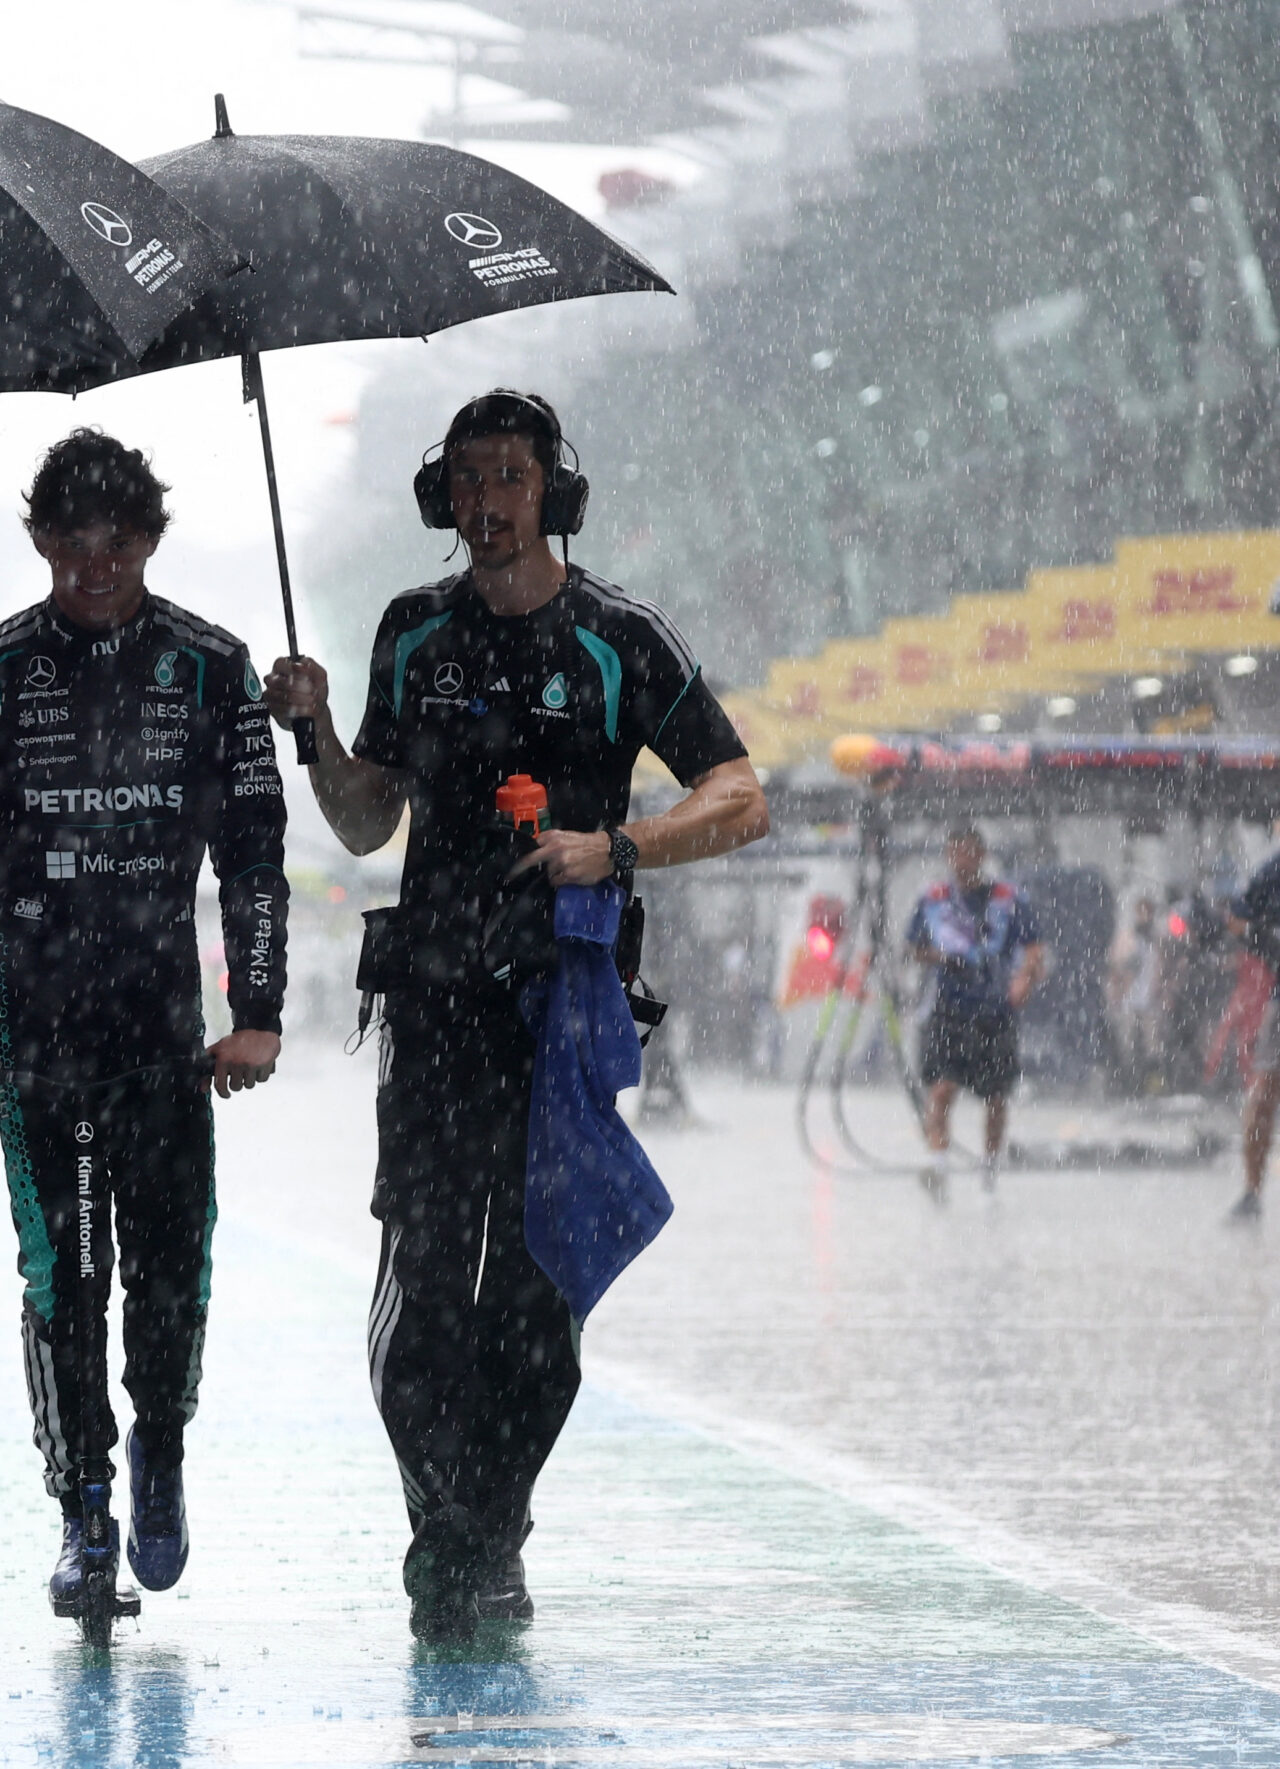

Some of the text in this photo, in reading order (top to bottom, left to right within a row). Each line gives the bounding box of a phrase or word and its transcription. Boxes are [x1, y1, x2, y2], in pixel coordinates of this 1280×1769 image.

[491, 248, 541, 264] AMG
[134, 249, 175, 286] PETRONAS
[473, 257, 551, 280] PETRONAS
[483, 273, 526, 288] FORMULA
[531, 267, 559, 278] TEAM
[34, 688, 69, 698] AMG
[37, 706, 69, 724] UBS
[531, 707, 571, 720] PETRONA
[19, 733, 76, 745] CROWDSTRIKE
[29, 755, 77, 766] Snapdragon
[146, 747, 184, 761] HPE
[24, 784, 184, 814] PETRONAS
[14, 900, 44, 917] OMP
[250, 893, 273, 967] Meta AI
[77, 1156, 93, 1195] Kimi
